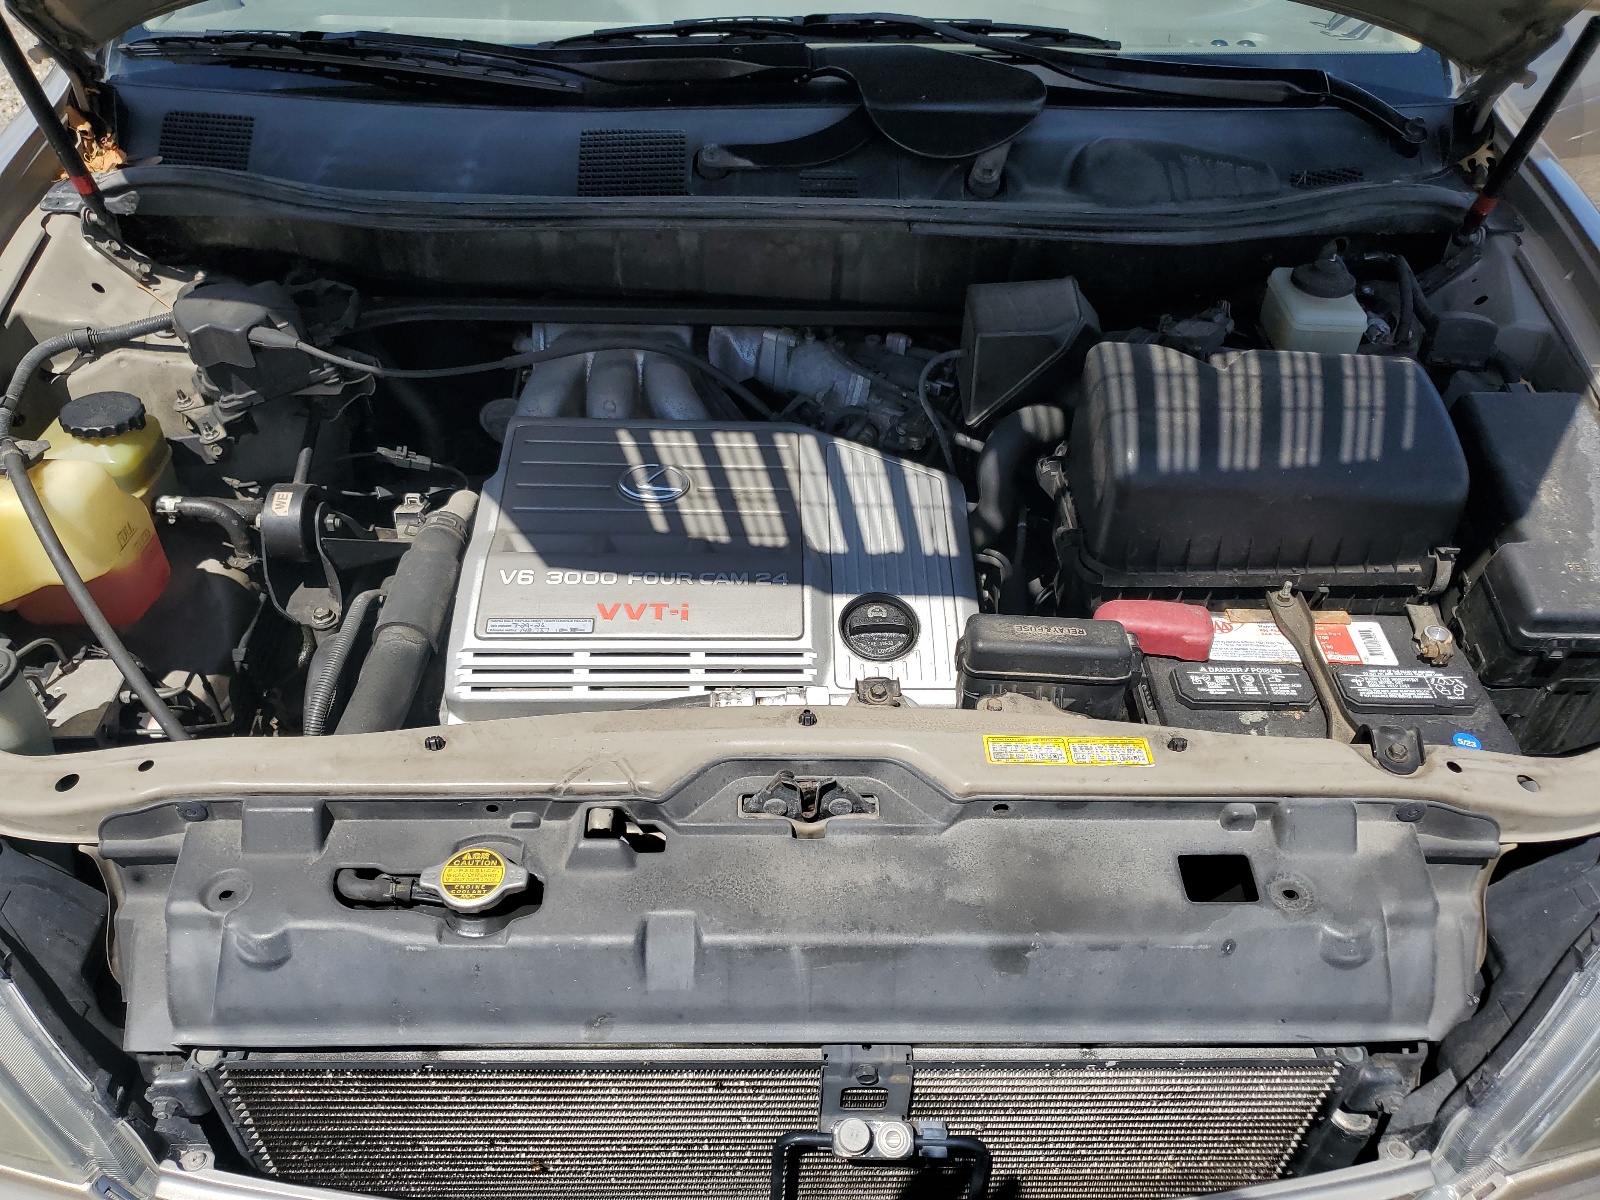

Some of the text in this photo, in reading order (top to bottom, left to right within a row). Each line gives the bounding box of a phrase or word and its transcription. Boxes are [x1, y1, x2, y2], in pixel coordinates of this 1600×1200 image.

[499, 569, 790, 586] V6 3000 FOUR CAM 24
[597, 603, 690, 622] VVT-i
[1457, 737, 1477, 748] 5/23
